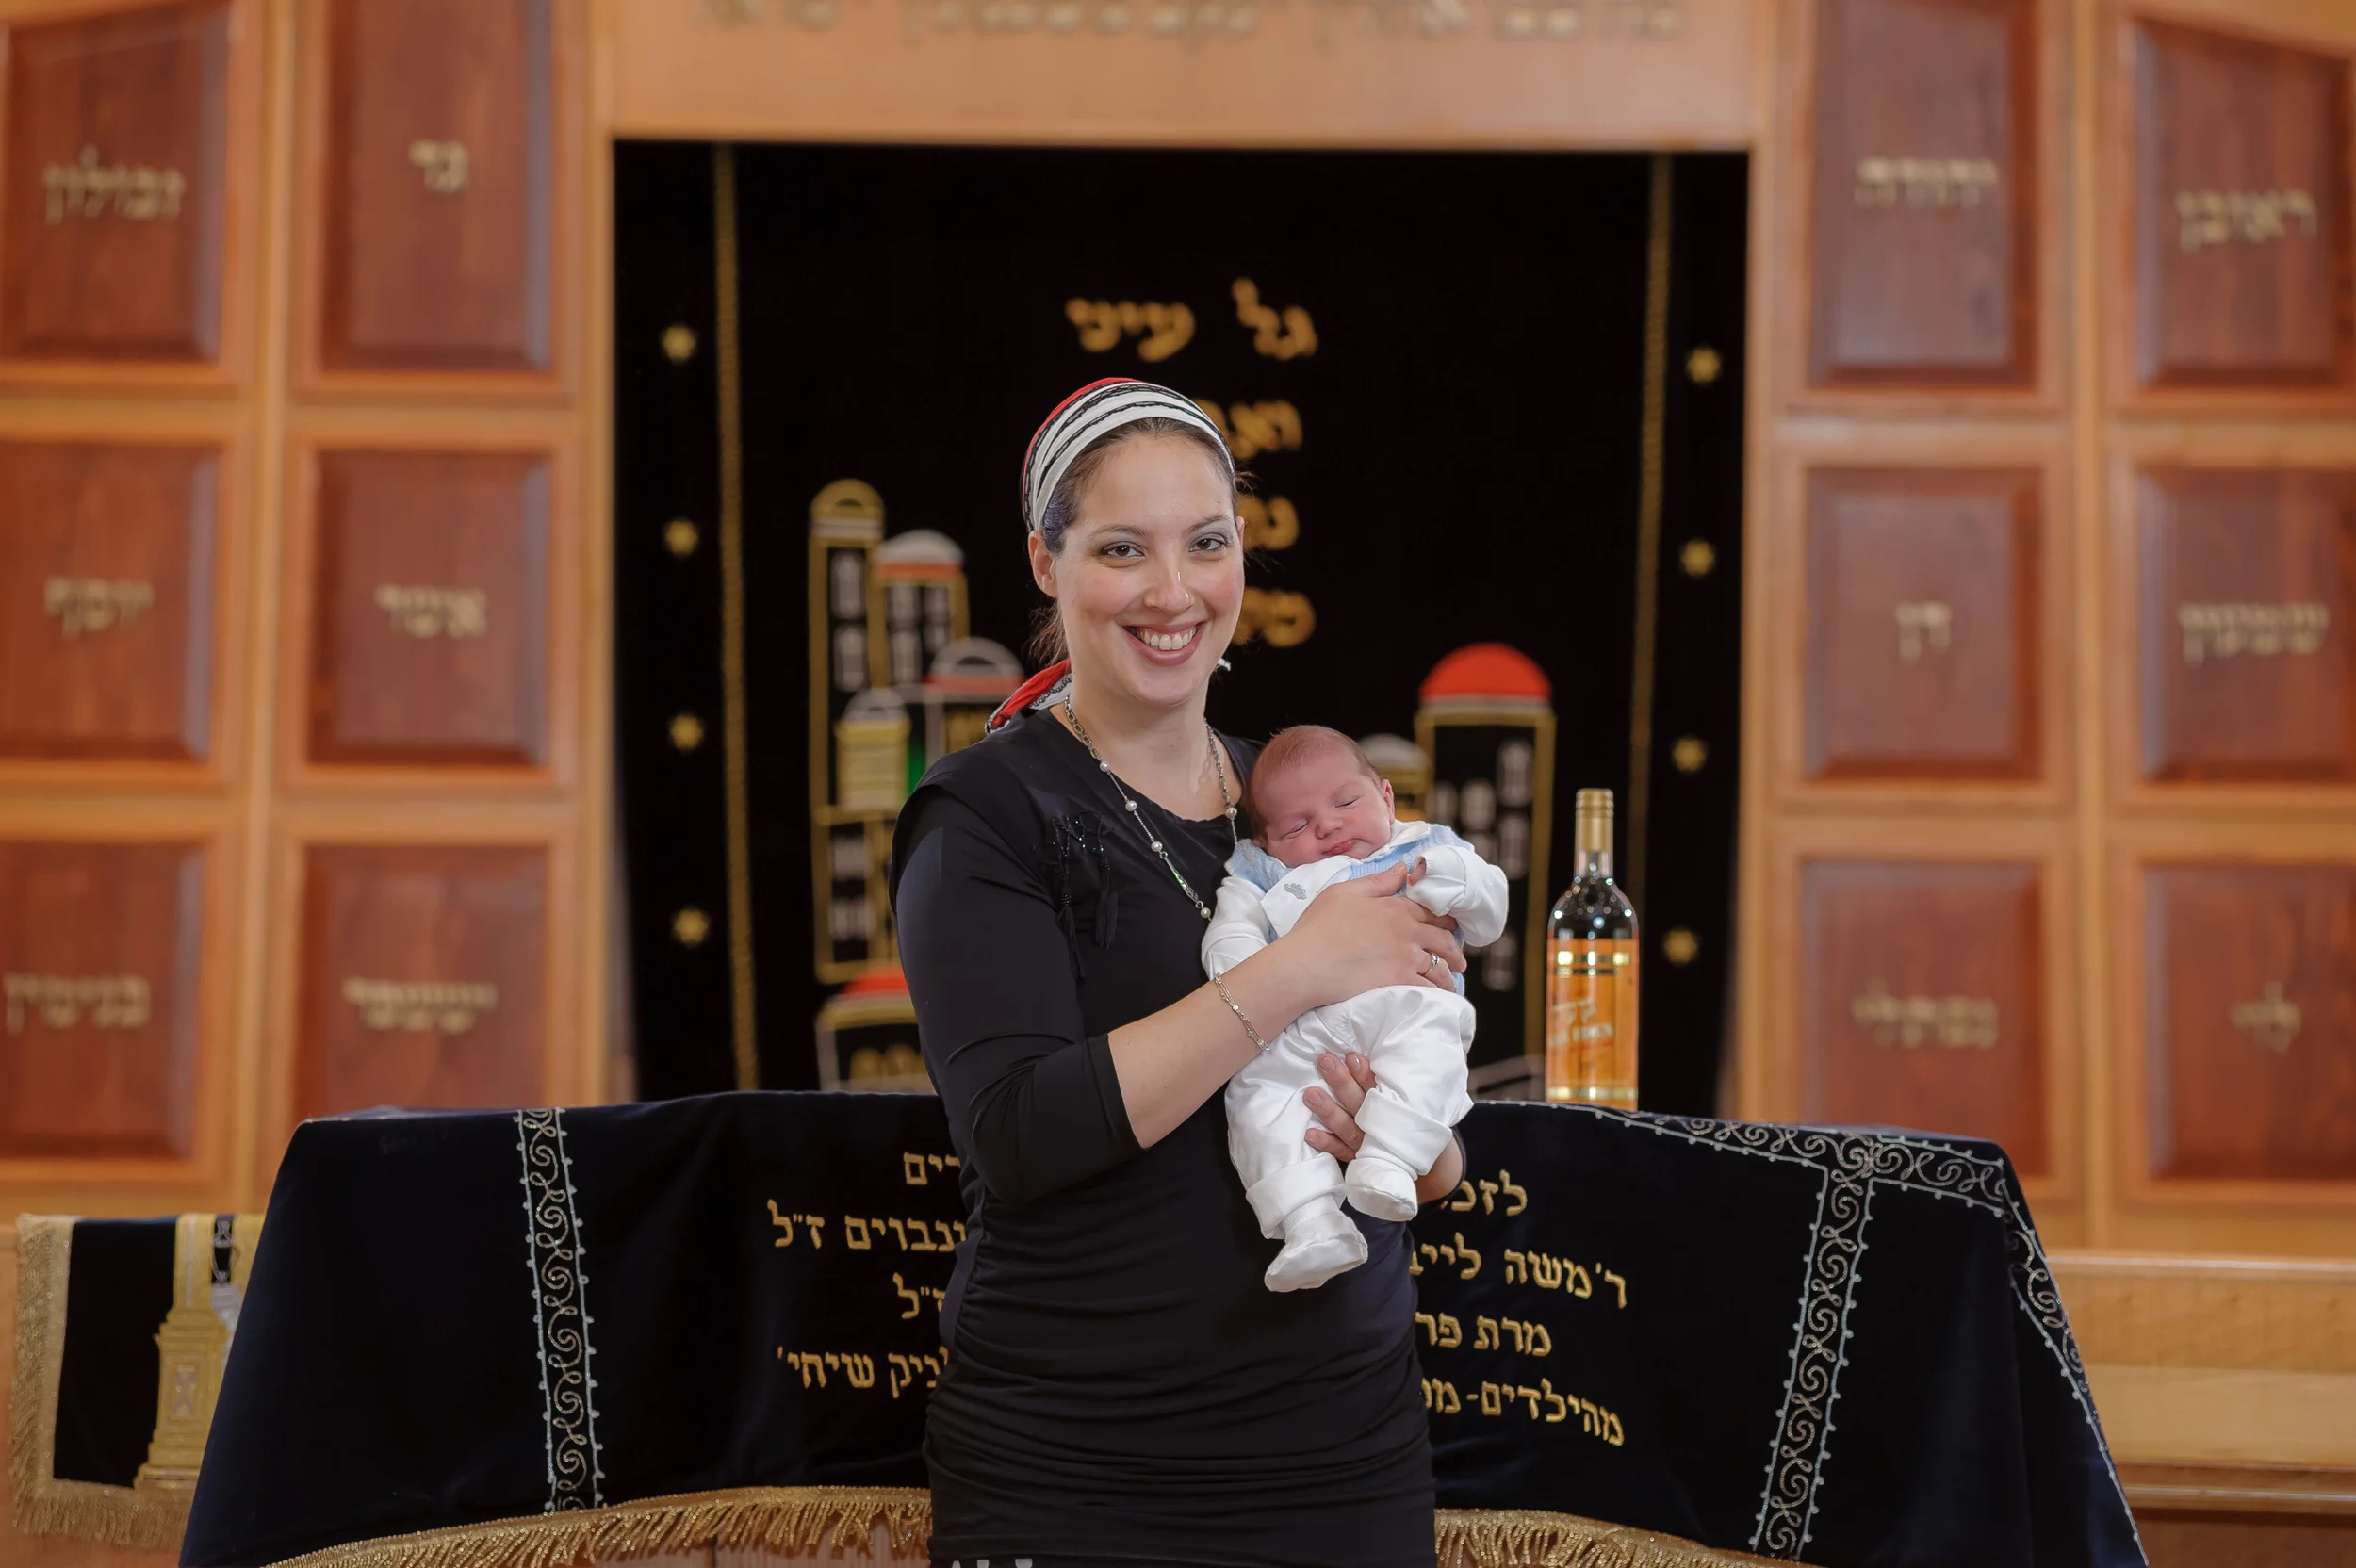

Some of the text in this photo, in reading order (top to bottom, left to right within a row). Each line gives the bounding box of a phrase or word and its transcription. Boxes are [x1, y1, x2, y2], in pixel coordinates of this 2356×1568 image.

[1065, 278, 1317, 362] גל עיני
[1440, 1169, 1528, 1216] לזכ
[1473, 1315, 1552, 1357] מרת
